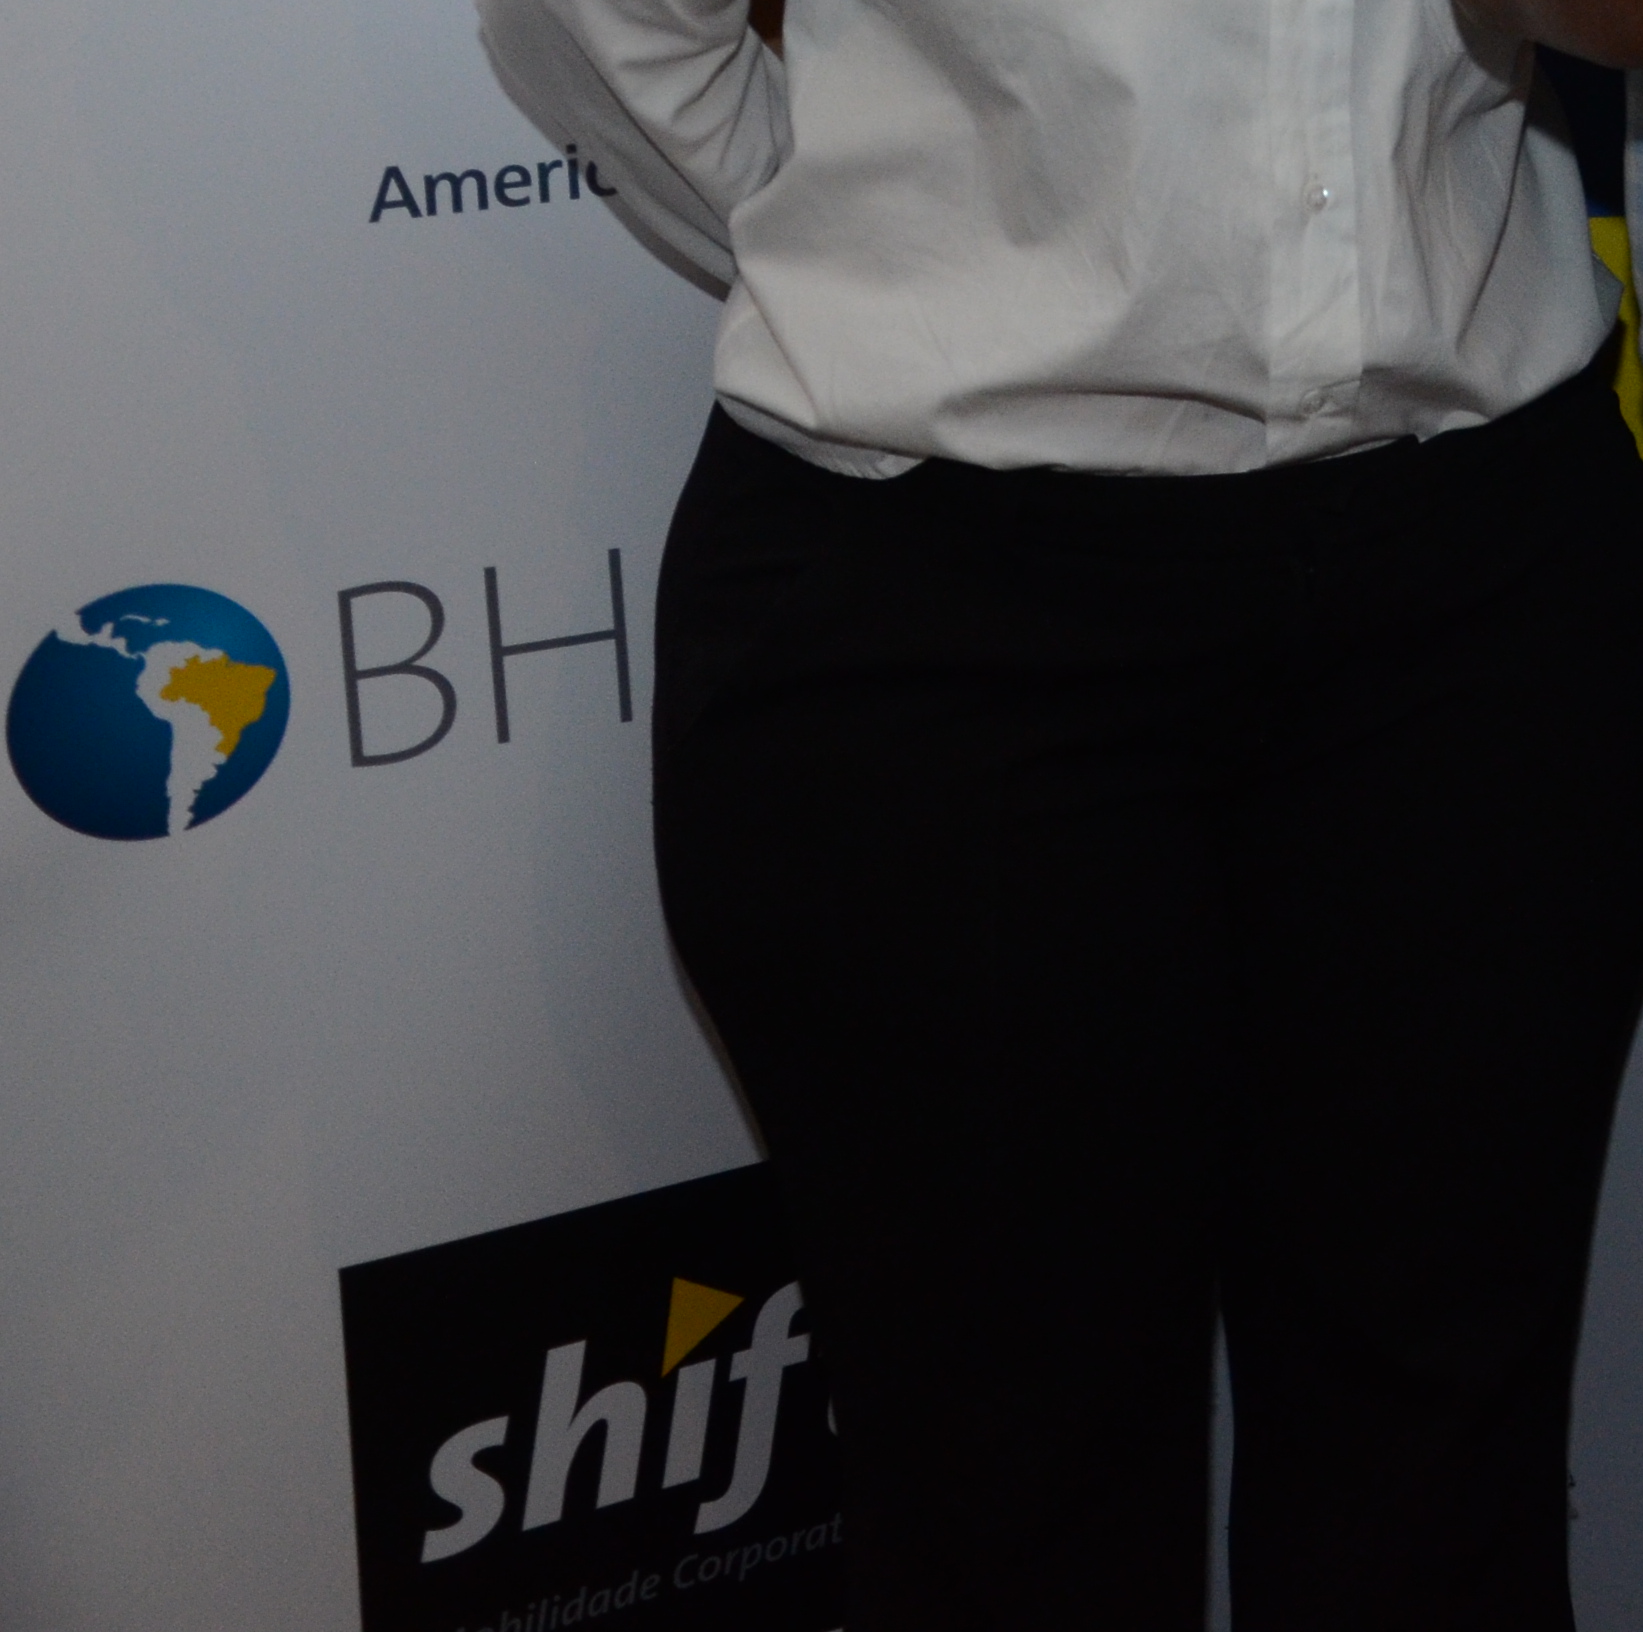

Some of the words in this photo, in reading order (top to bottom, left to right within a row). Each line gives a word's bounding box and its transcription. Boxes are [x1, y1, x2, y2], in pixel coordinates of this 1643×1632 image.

[367, 144, 617, 224] Americ
[337, 548, 633, 768] BH
[420, 1276, 838, 1565] shif
[456, 1570, 660, 1632] bilidade
[673, 1512, 844, 1582] Corporat
